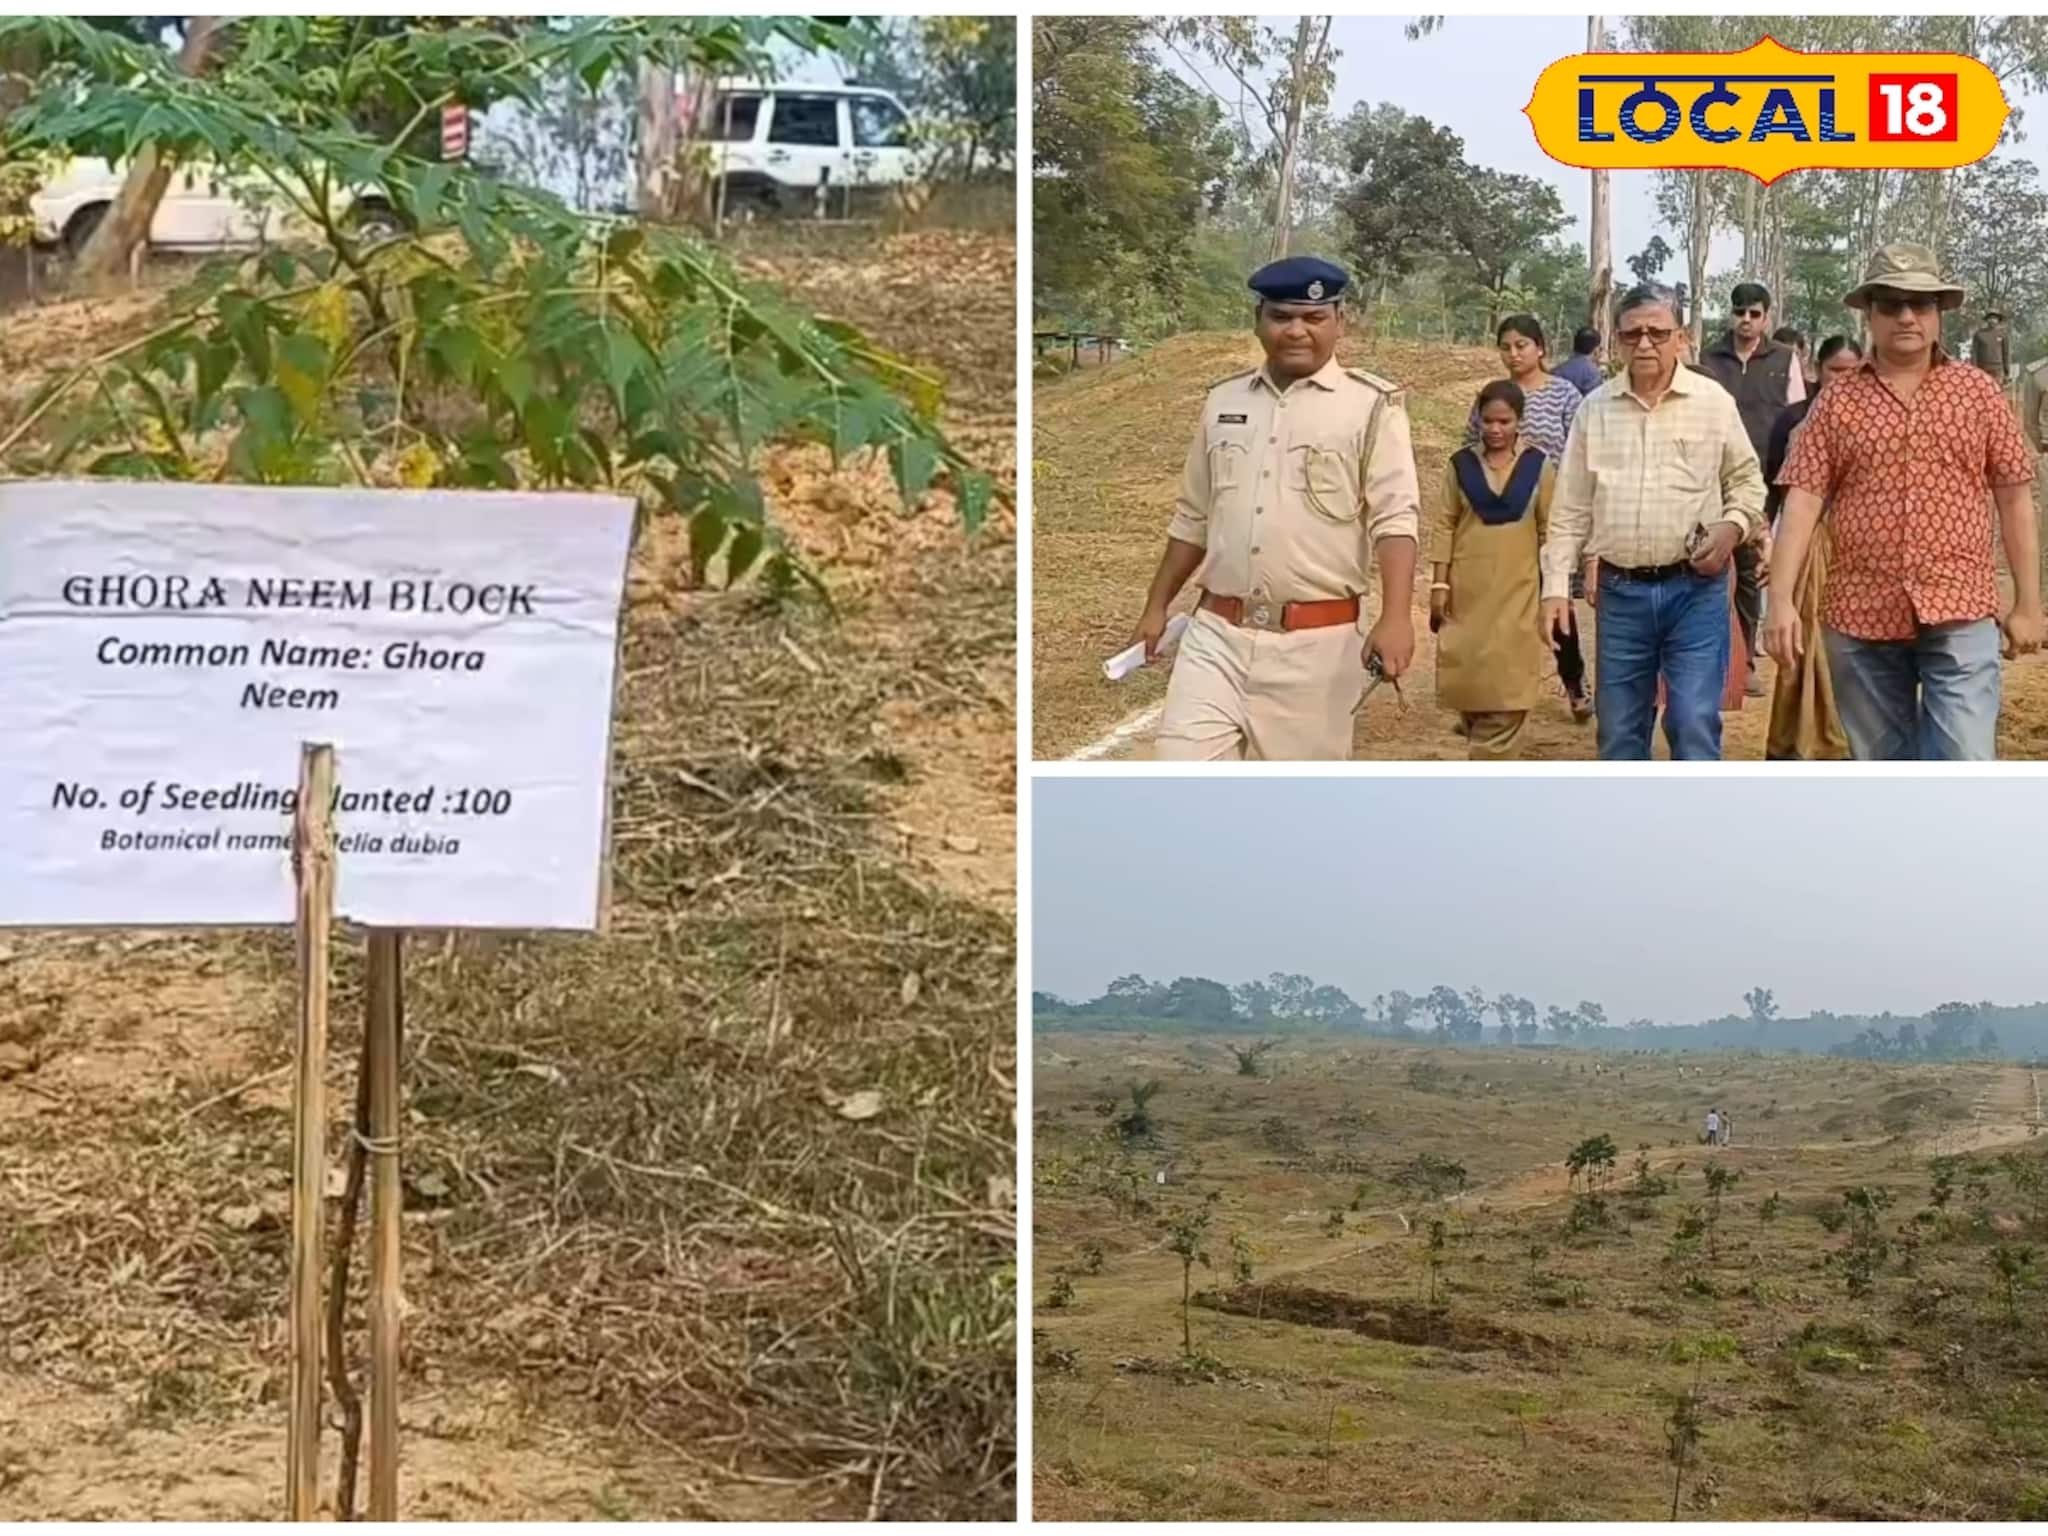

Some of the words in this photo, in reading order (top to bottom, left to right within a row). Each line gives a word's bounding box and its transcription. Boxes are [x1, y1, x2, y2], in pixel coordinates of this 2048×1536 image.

[62, 574, 226, 610] GHORA
[246, 578, 372, 612] NEEM
[388, 580, 538, 616] BLOCK
[97, 636, 248, 667] Common
[259, 638, 372, 671] Name:
[382, 642, 485, 671] Ghora
[240, 682, 339, 711] Neem
[51, 782, 107, 811] No.
[118, 782, 153, 814] of
[328, 784, 432, 816] lanted
[440, 788, 512, 817] :100
[100, 828, 220, 852] Botanical
[330, 832, 384, 855] elia
[390, 834, 460, 857] dubia
